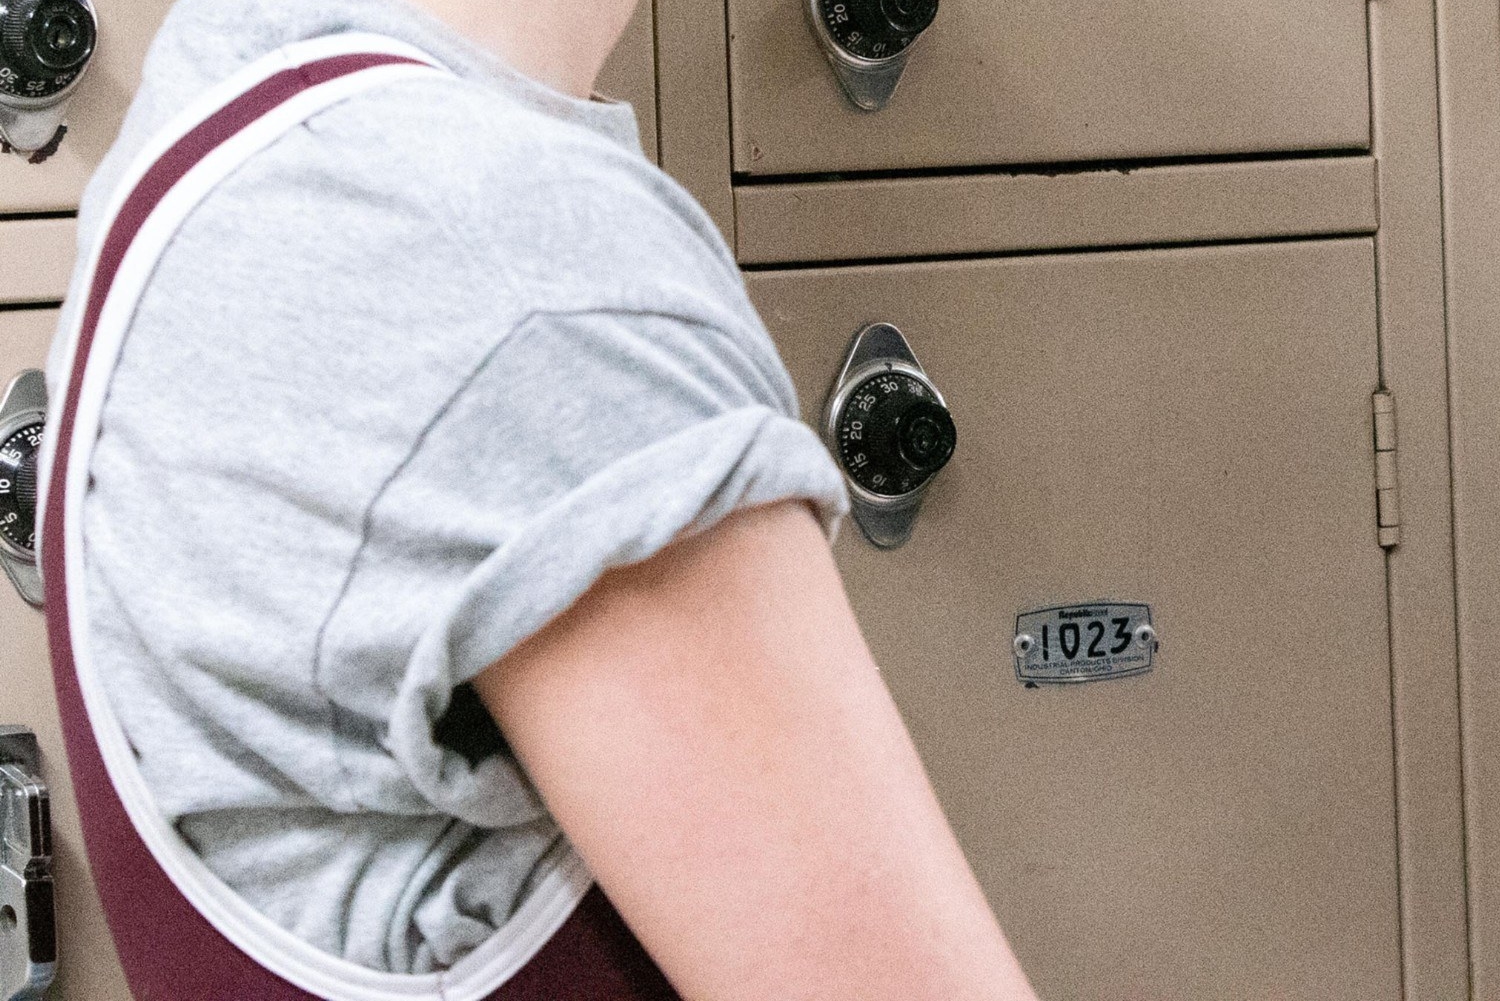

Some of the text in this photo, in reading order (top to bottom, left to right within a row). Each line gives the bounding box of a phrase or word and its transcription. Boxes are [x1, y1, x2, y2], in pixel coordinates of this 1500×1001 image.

[834, 4, 849, 23] 20
[880, 381, 899, 394] 30
[858, 394, 877, 411] 25
[850, 420, 863, 440] 20
[1041, 617, 1132, 662] 1023
